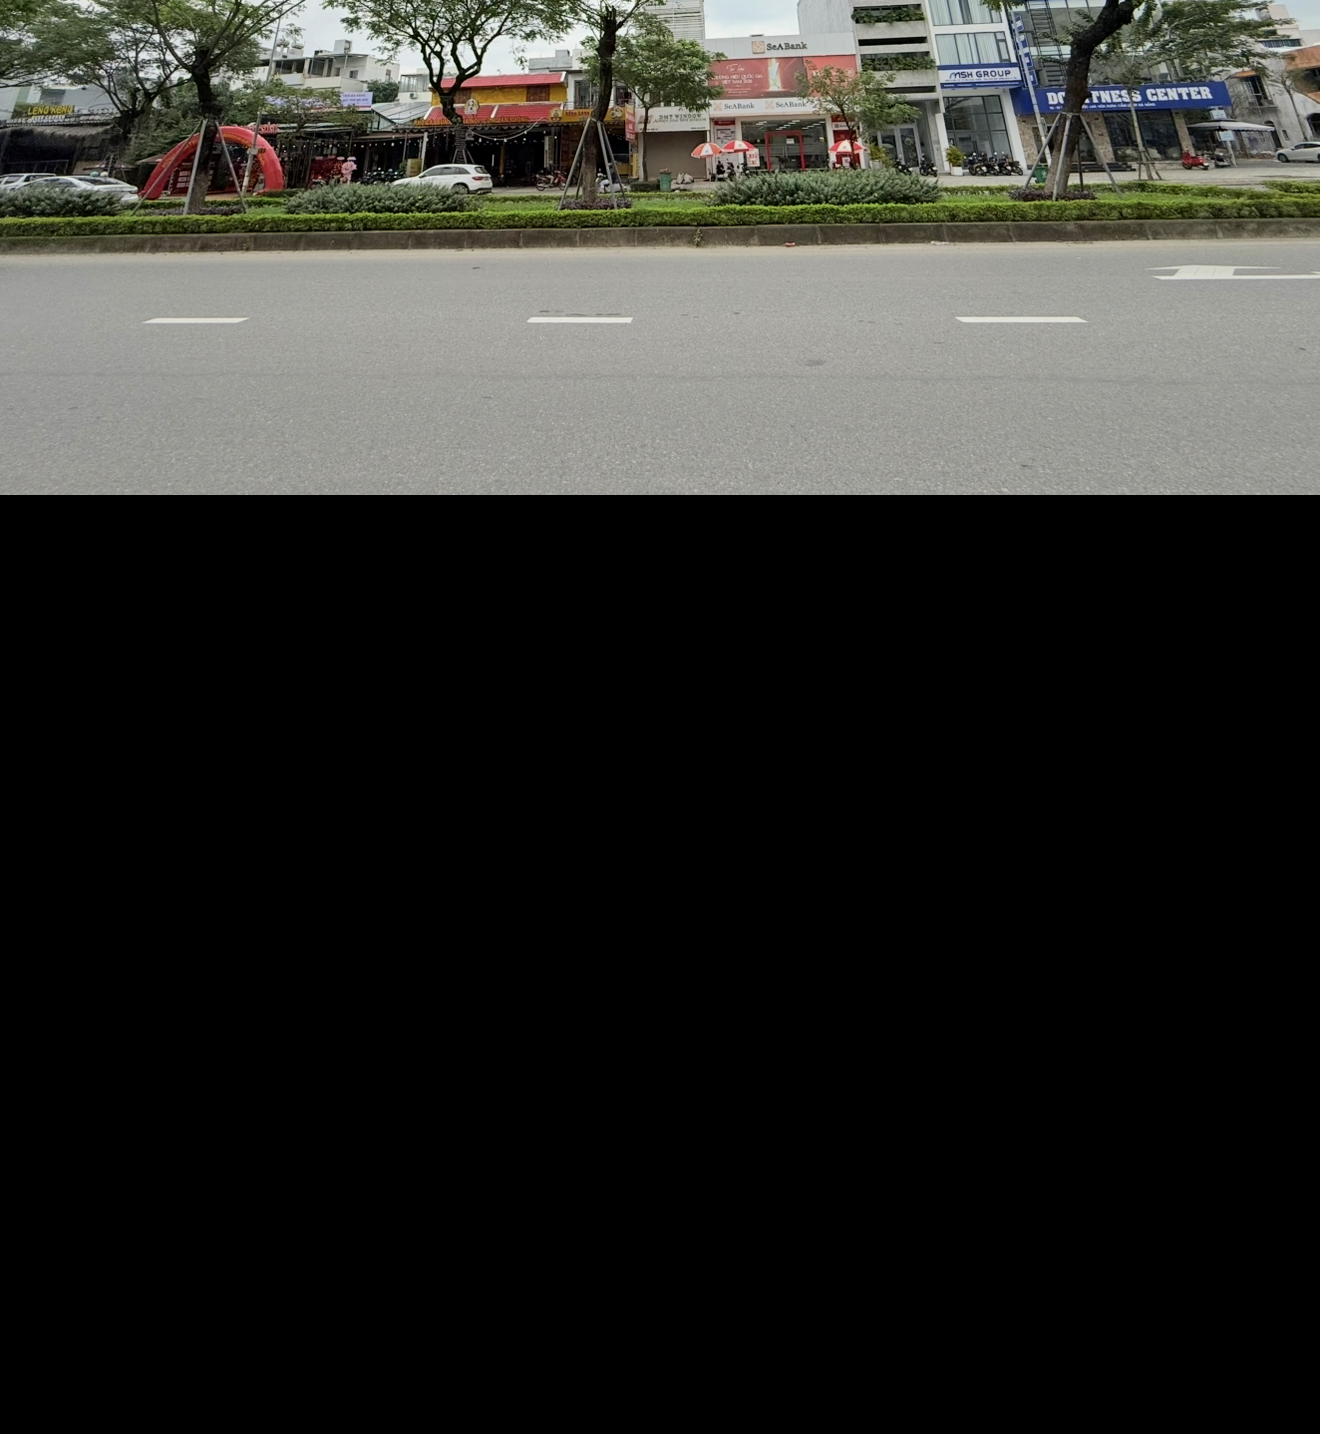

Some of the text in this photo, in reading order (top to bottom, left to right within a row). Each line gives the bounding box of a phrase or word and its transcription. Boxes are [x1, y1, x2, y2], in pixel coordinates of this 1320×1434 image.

[766, 42, 808, 51] SeABank
[975, 69, 1011, 78] GROUP
[1146, 86, 1213, 102] CENTER
[724, 101, 807, 110] SeABank SeABank
[28, 106, 49, 115] LENG
